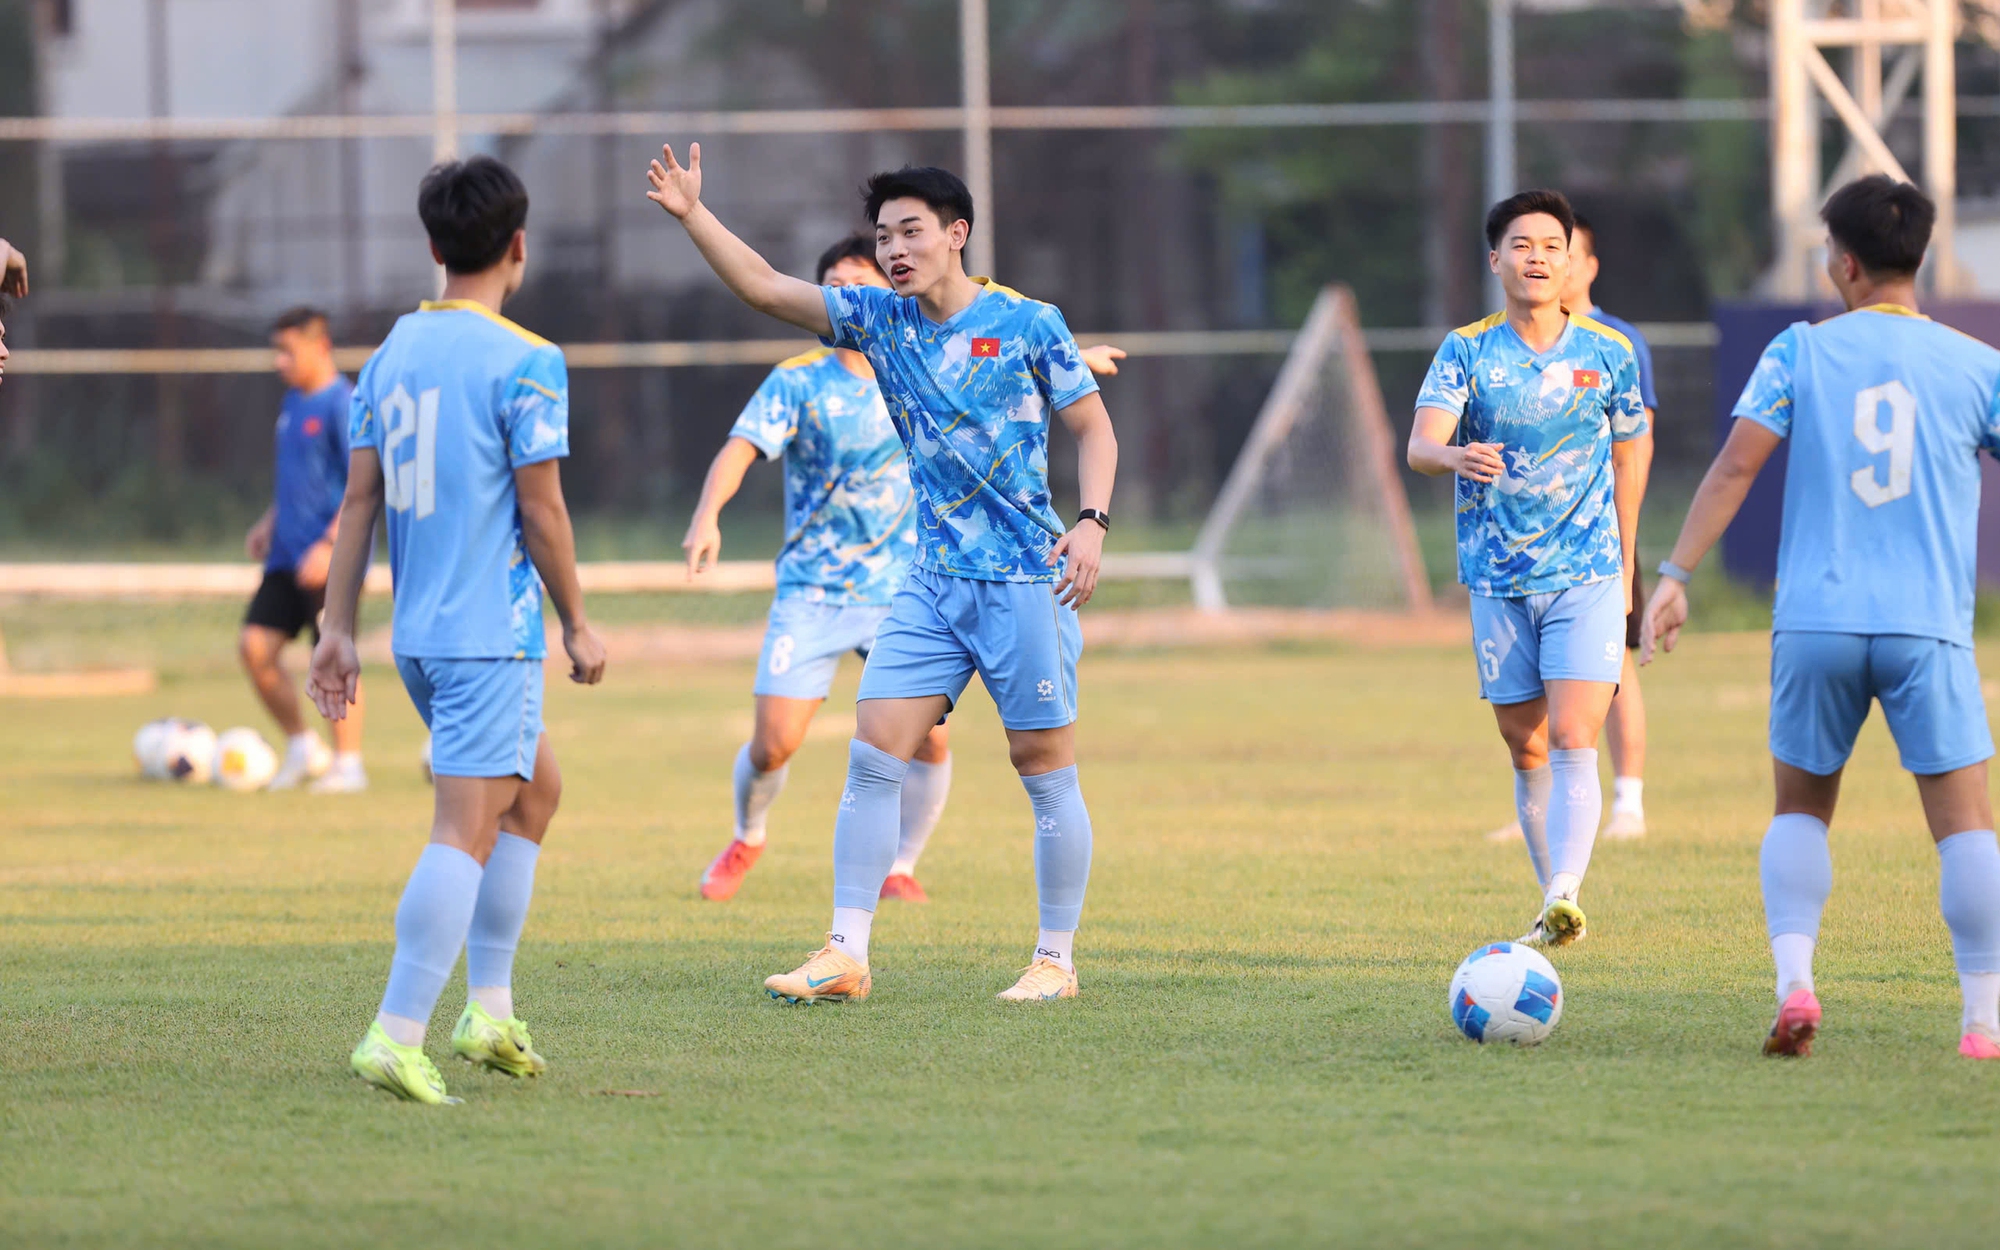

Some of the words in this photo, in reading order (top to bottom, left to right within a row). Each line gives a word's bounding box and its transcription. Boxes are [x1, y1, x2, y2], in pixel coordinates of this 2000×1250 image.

[380, 382, 440, 519] 21
[1851, 380, 1916, 508] 9
[770, 634, 795, 675] 8
[1481, 638, 1500, 682] 5
